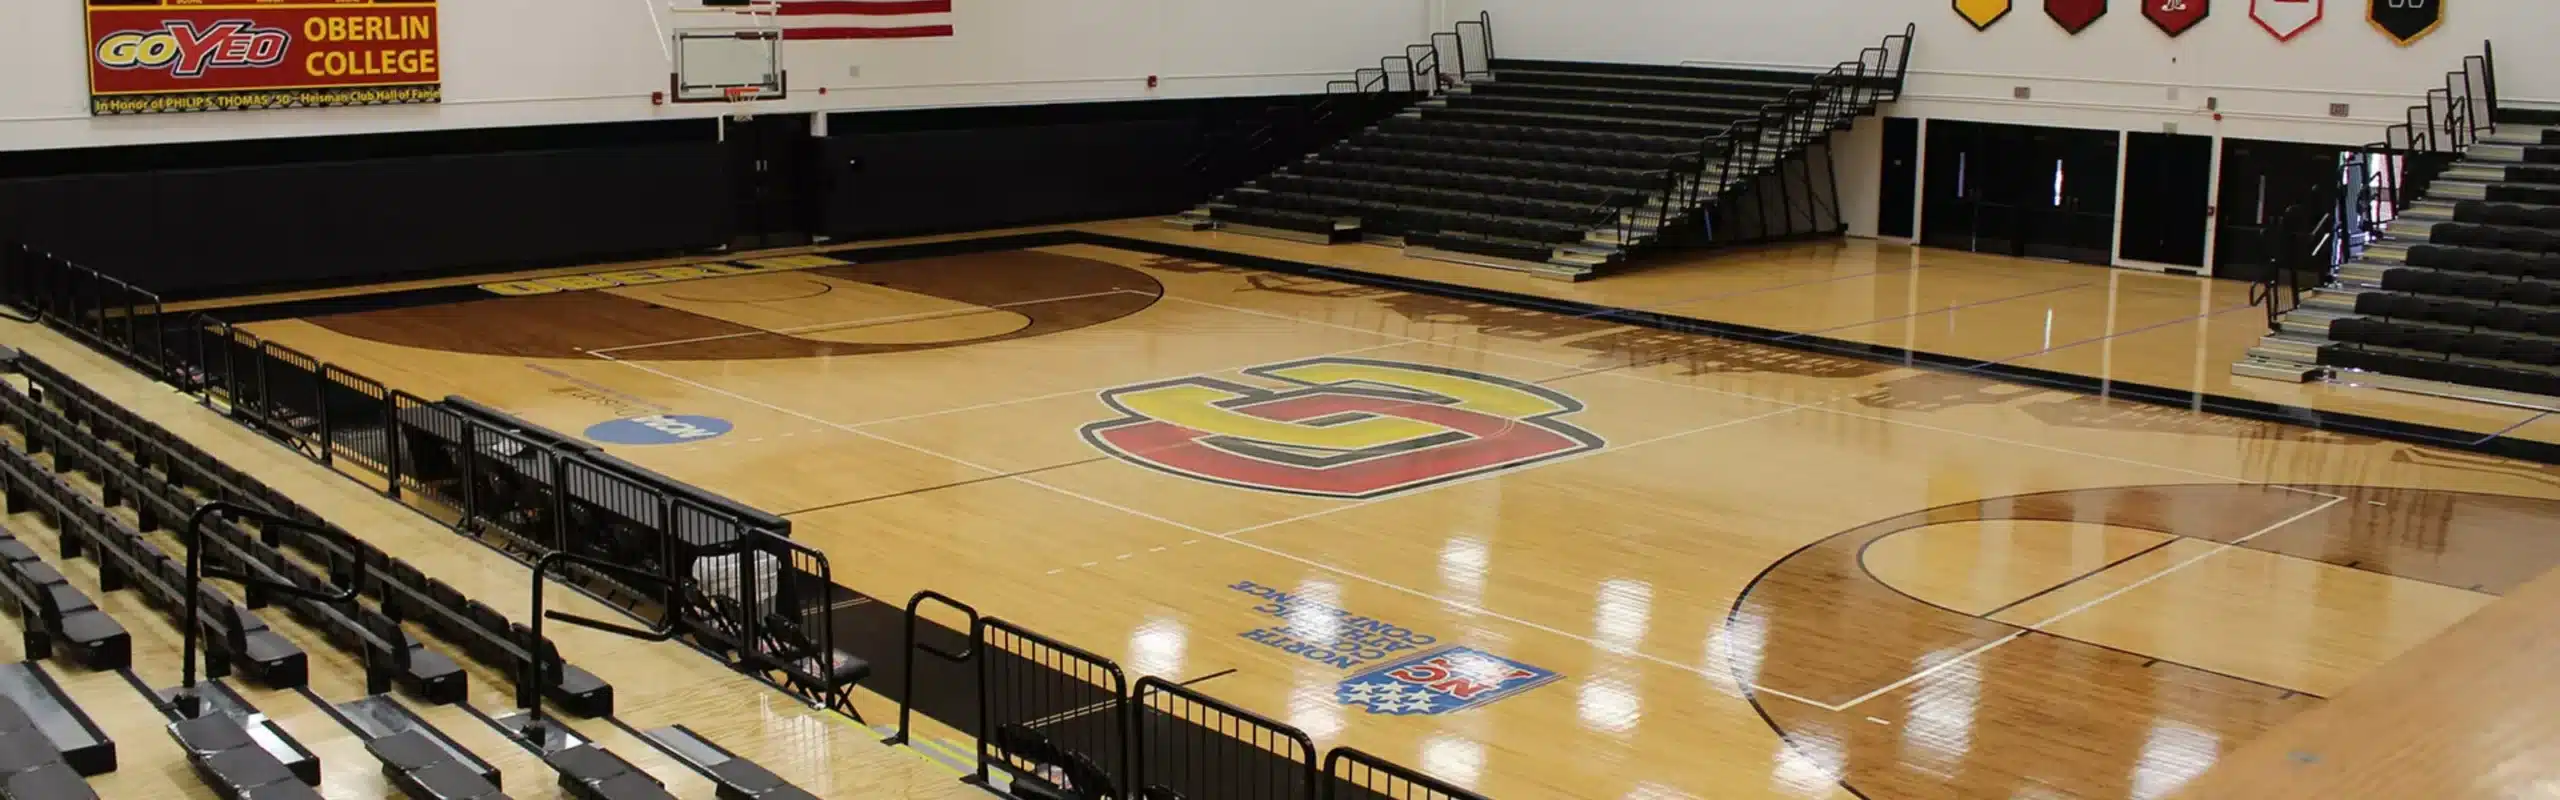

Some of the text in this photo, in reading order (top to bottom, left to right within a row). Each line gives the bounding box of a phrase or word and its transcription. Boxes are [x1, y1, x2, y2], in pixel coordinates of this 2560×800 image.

[304, 16, 430, 42] OBERLIN
[305, 50, 436, 76] COLLEGE
[96, 100, 108, 111] In
[111, 99, 148, 110] Honor
[151, 98, 163, 109] of
[166, 96, 204, 108] PHILIP
[217, 95, 268, 106] THOMAS
[300, 92, 348, 103] Heisman
[351, 90, 375, 101] Club
[377, 89, 397, 101] Hall
[399, 88, 410, 99] of
[413, 88, 441, 99] Fame
[1236, 627, 1364, 670] NORTH
